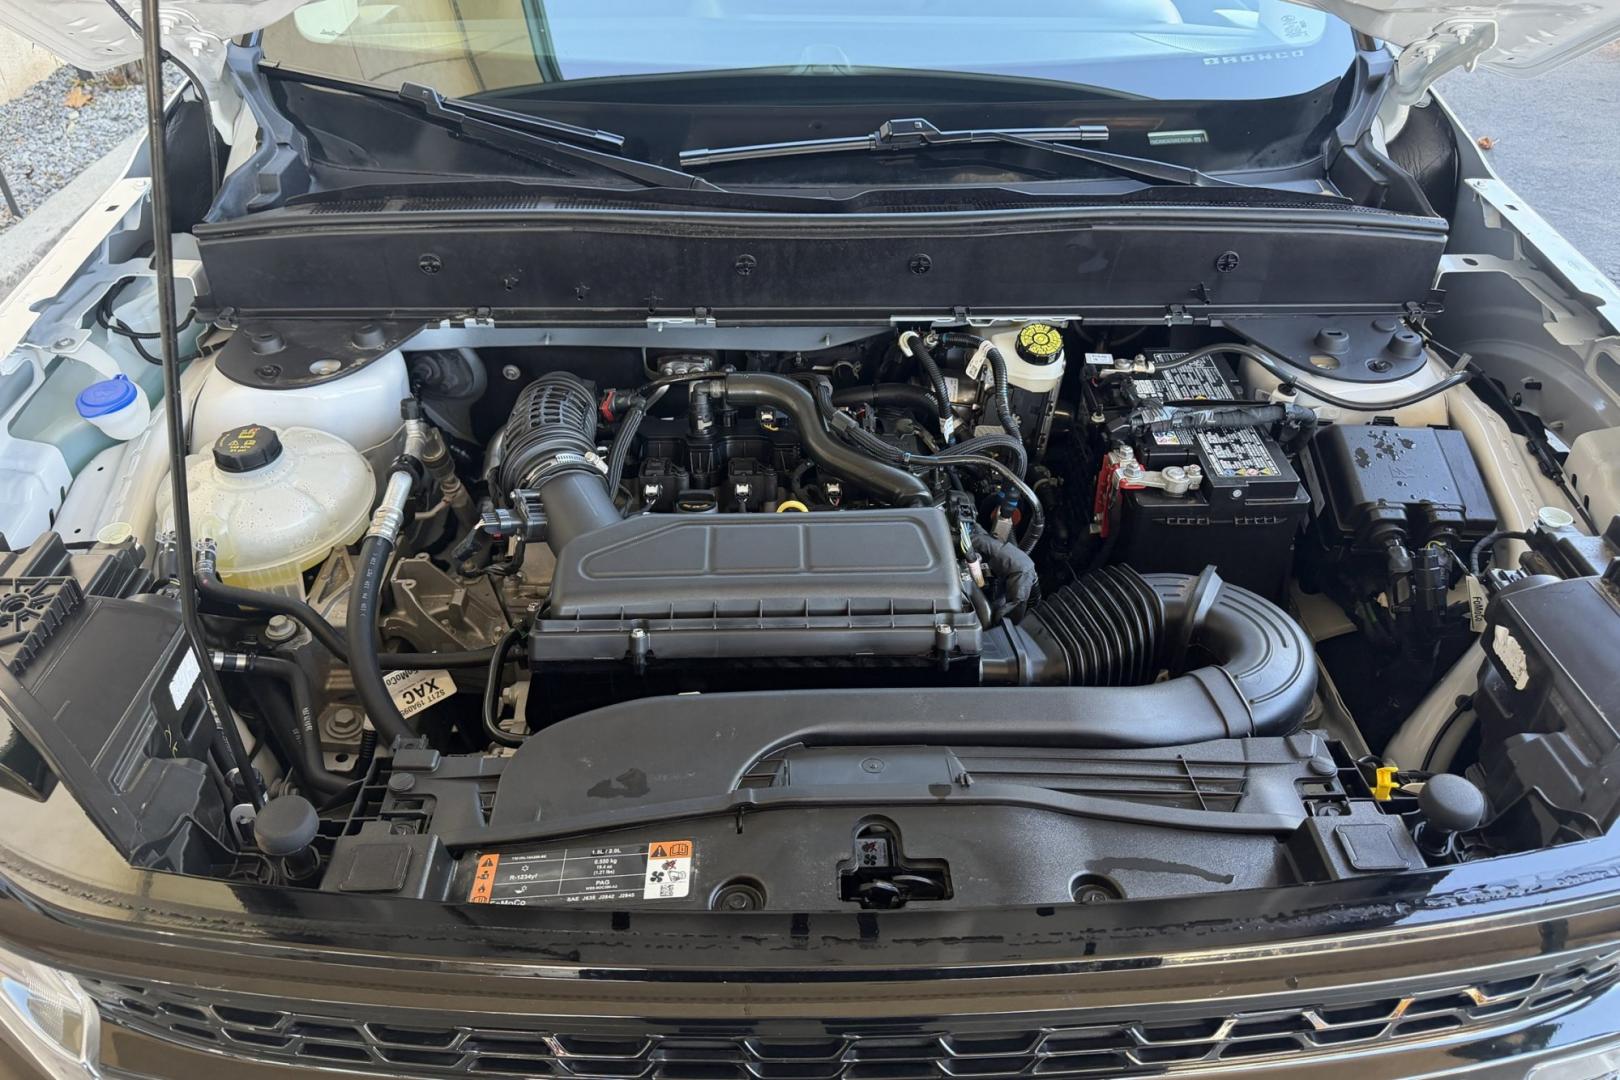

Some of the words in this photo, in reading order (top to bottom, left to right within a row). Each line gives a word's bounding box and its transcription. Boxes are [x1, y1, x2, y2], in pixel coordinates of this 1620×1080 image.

[1472, 596, 1485, 622] FoMoCo
[402, 678, 440, 704] XAC
[509, 873, 538, 881] R-1234yf
